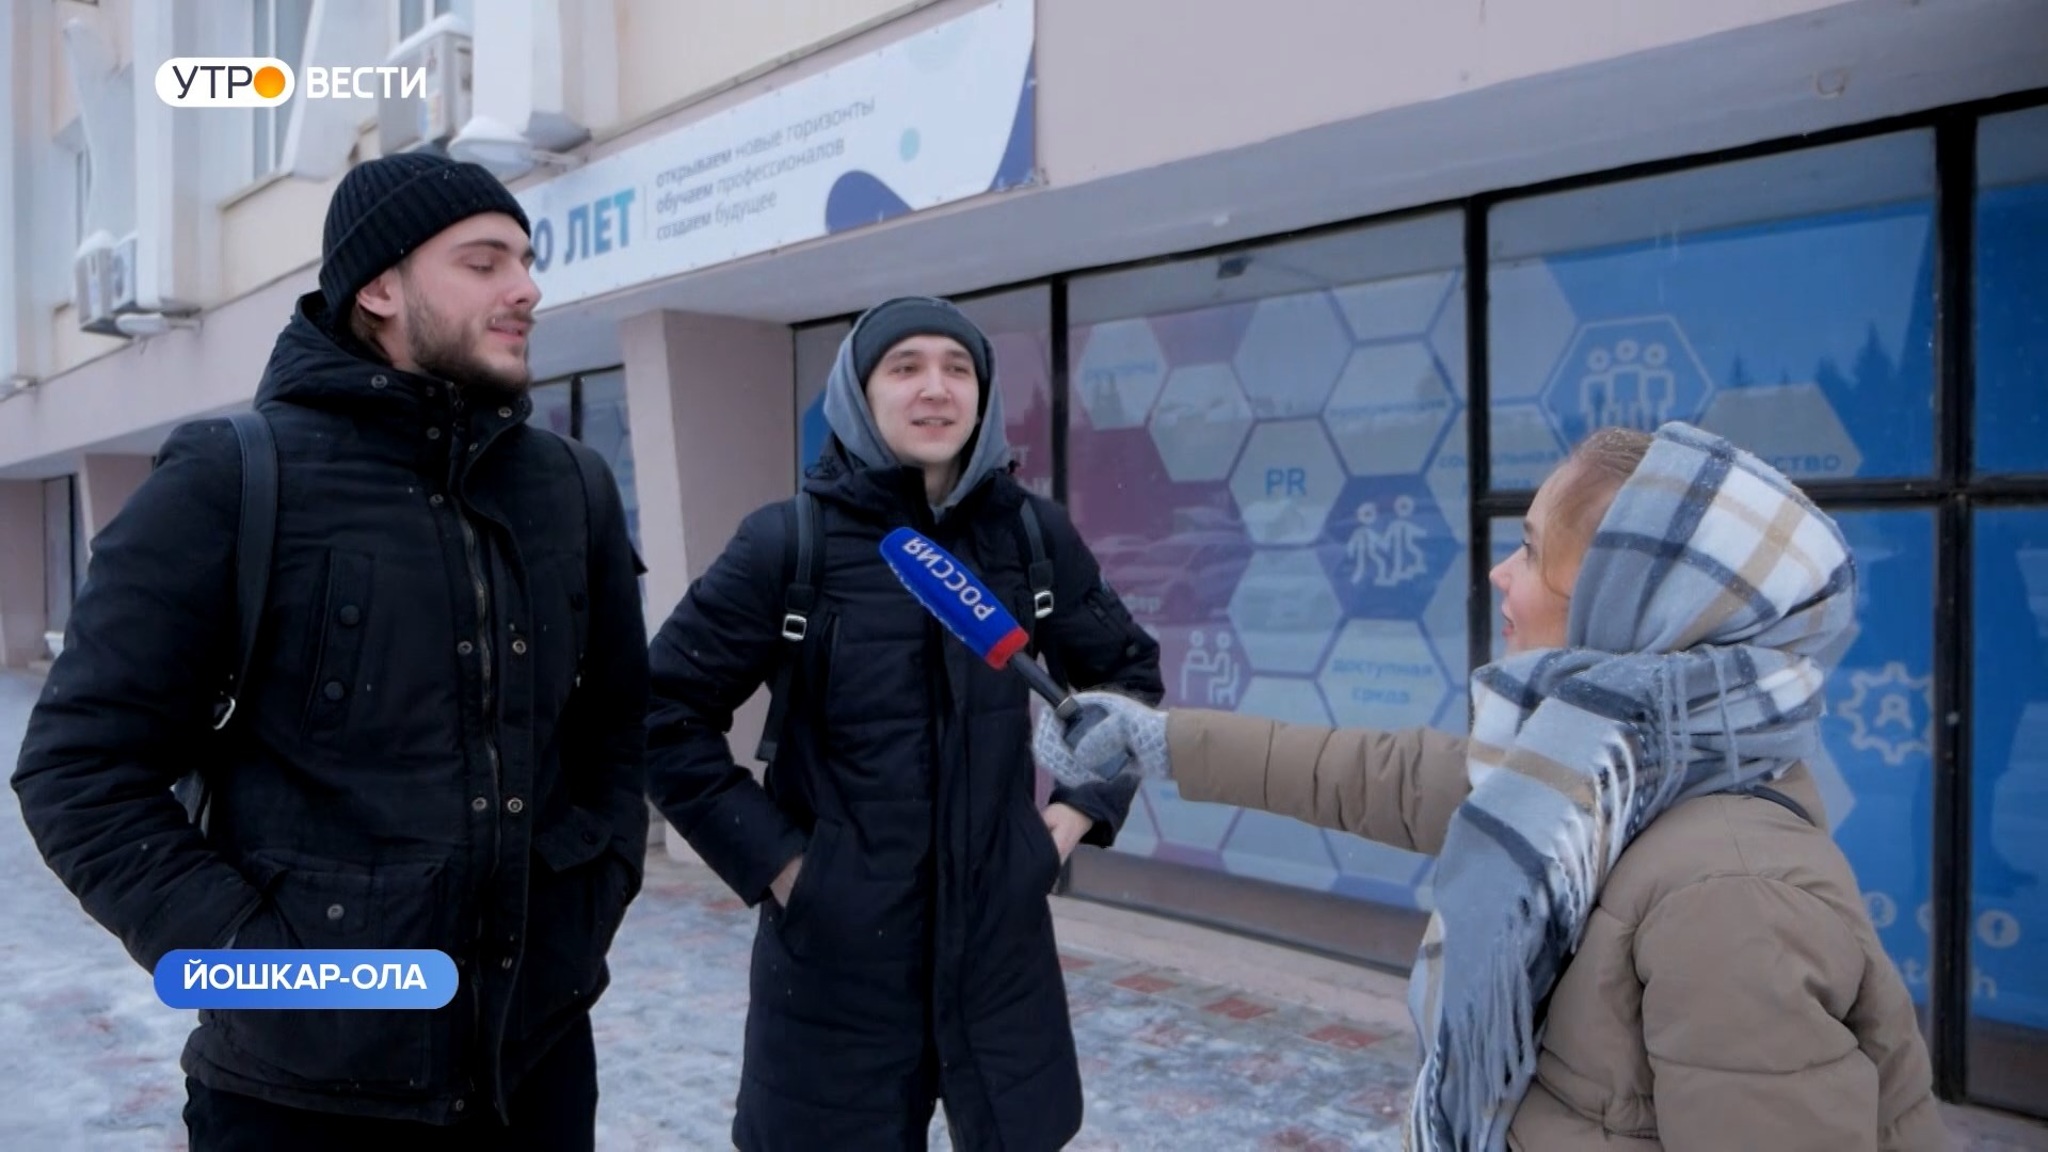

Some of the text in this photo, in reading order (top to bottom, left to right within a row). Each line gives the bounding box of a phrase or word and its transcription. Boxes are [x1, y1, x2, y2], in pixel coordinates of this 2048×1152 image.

[656, 98, 875, 188] открываем новые горизонты
[656, 138, 845, 215] обучаем профессионалов
[564, 187, 636, 266] ЛЕТ
[656, 190, 777, 241] создаем будущее
[1265, 467, 1307, 497] PR
[901, 536, 997, 621] РОССИЯ
